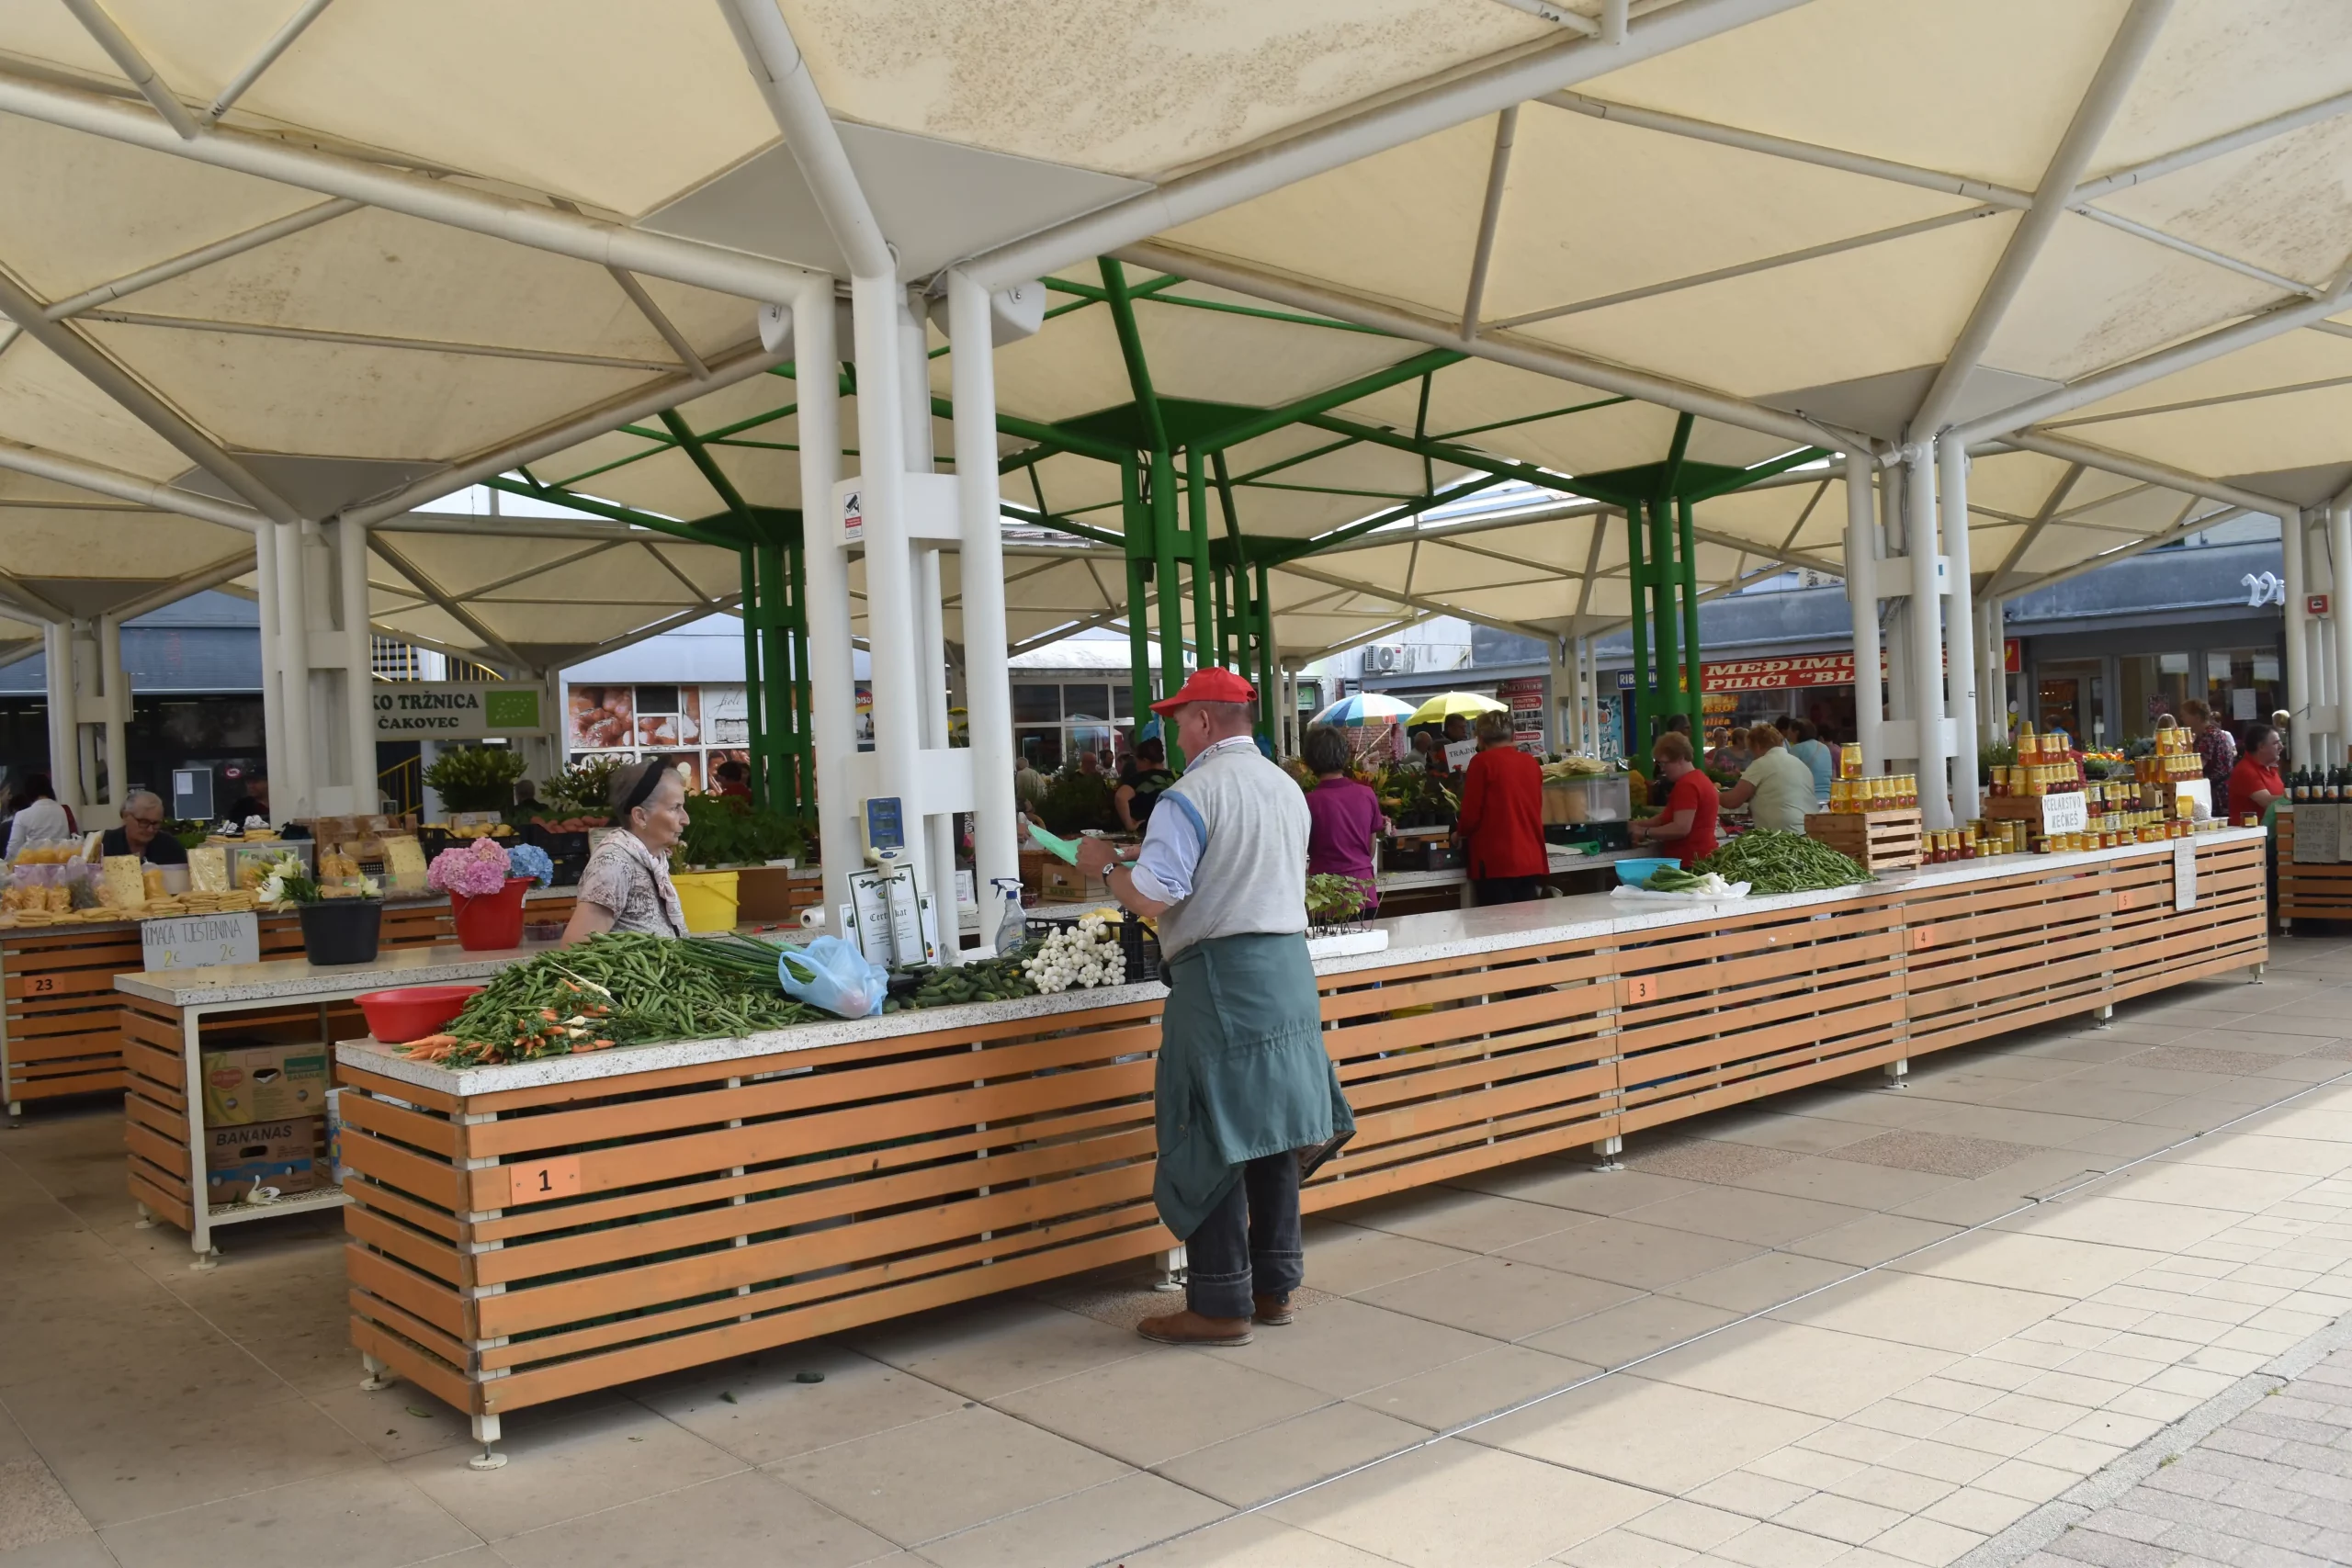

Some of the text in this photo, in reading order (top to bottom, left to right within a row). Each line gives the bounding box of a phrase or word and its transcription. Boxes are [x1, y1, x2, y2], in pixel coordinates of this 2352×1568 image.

[1705, 655, 1854, 676] MEĐIMU
[1706, 671, 1788, 691] PILIĆI
[373, 690, 480, 710] KO TRŽNICA
[378, 715, 459, 729] ČAKOVEC
[2043, 795, 2081, 813] PČELARSTVO
[1920, 931, 1926, 943] 4
[36, 978, 53, 991] 23
[1639, 982, 1646, 998] 3
[216, 1124, 293, 1146] BANANAS
[538, 1168, 553, 1192] 1
